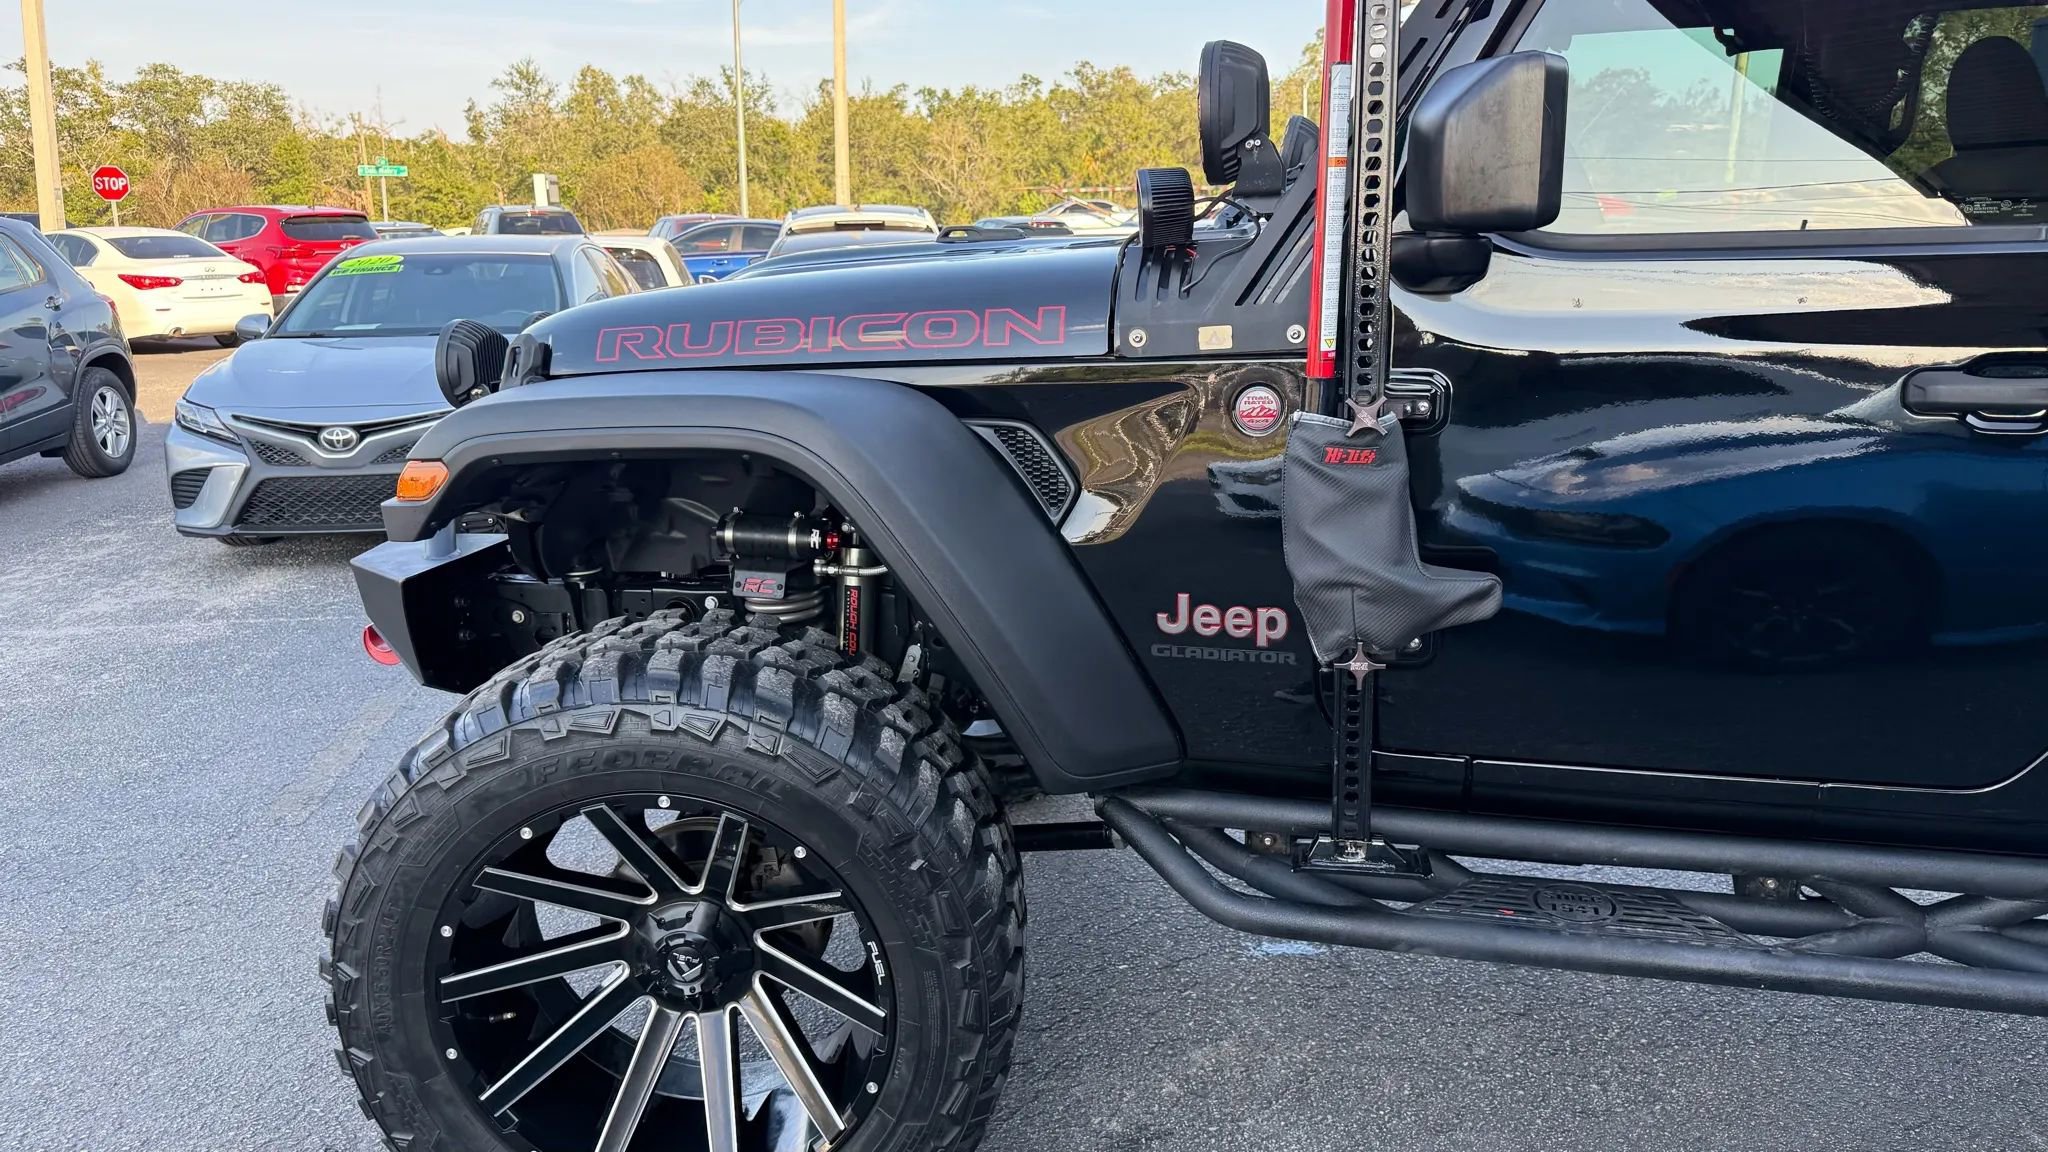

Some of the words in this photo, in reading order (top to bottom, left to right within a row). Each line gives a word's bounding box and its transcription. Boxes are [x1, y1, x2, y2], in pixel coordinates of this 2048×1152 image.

[95, 176, 127, 190] STOP
[344, 256, 394, 267] 2020
[349, 264, 395, 274] FINANCE
[596, 306, 1066, 361] RUBICON
[743, 577, 778, 594] RC
[850, 588, 859, 629] ROUGH
[1156, 592, 1288, 647] Jeep
[849, 632, 857, 656] COU
[1151, 644, 1297, 665] GLADIATOR
[532, 748, 784, 803] FEDERAL
[672, 952, 700, 964] FUEL
[867, 940, 886, 986] FUEL
